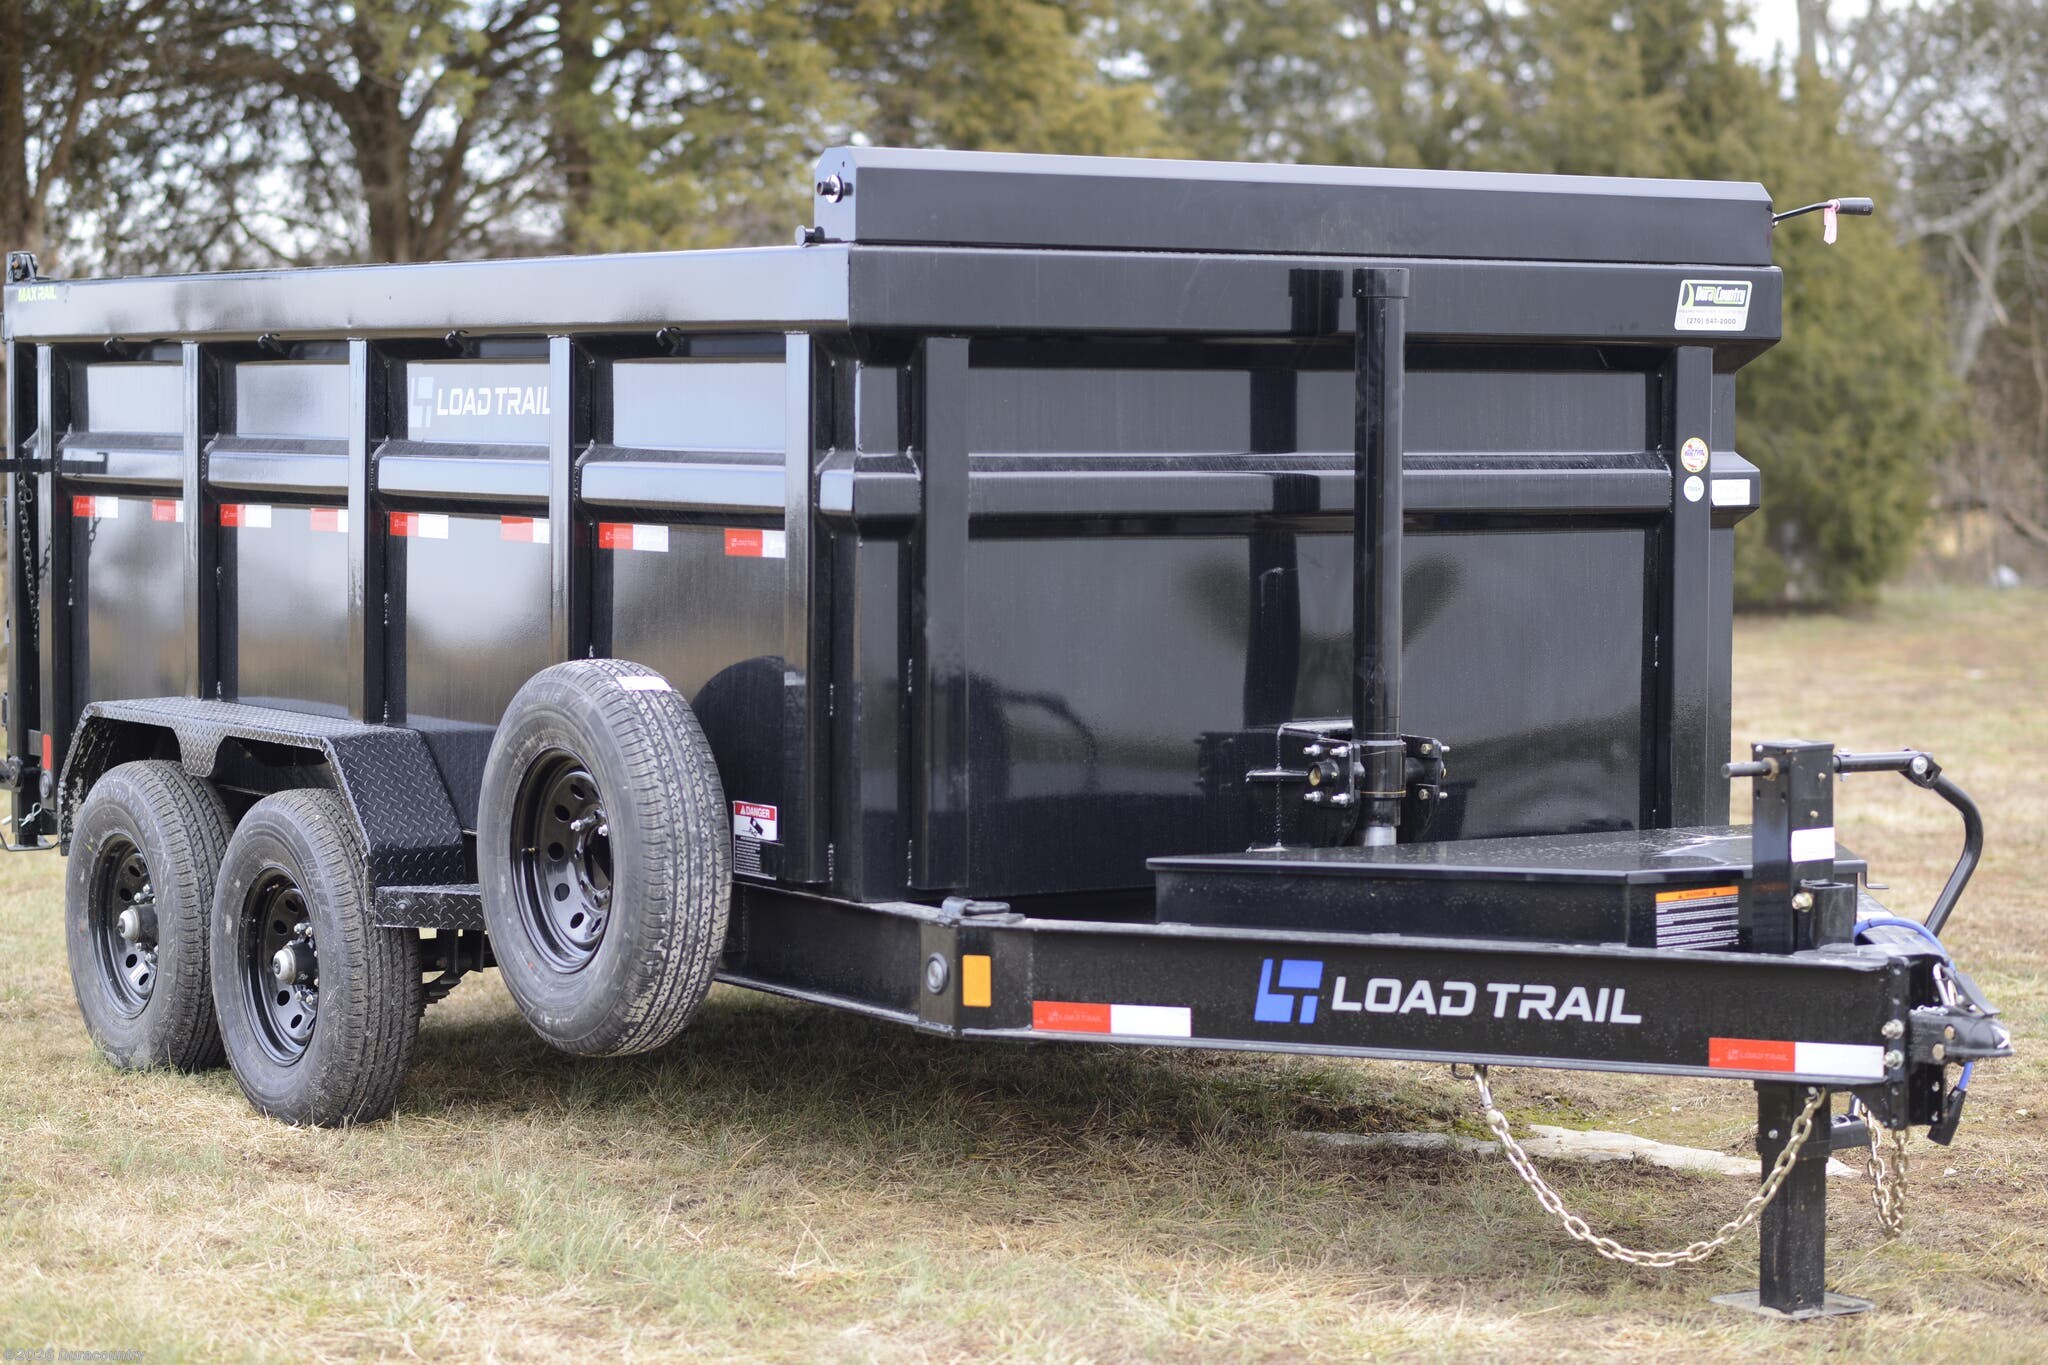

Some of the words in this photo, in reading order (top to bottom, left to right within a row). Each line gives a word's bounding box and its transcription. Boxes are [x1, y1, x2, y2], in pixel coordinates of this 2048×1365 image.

[18, 286, 37, 302] MAX
[37, 286, 57, 300] RAIL
[437, 387, 491, 416] LOAD
[495, 385, 551, 415] TRAIL
[745, 806, 770, 819] DANGER
[1331, 975, 1478, 1017] LOAD
[1486, 983, 1642, 1024] TRAIL
